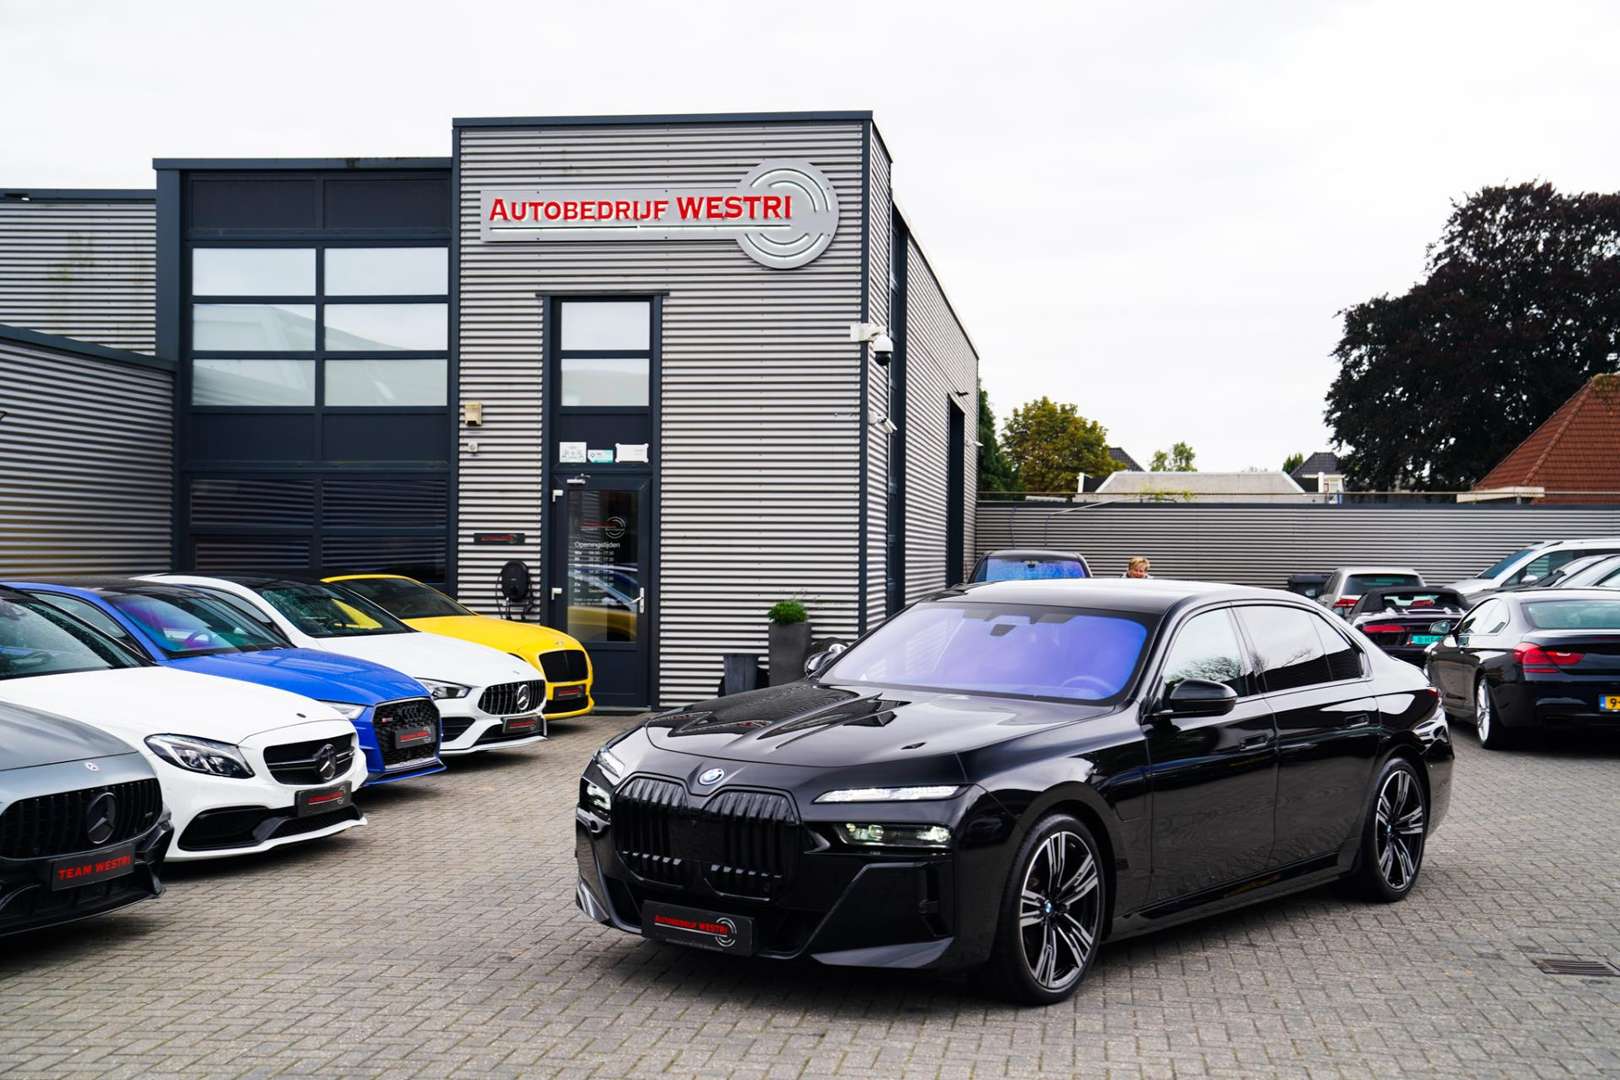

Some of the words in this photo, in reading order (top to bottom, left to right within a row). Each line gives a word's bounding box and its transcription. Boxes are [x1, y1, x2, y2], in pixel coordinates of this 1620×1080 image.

[489, 198, 669, 221] AUTOBEDRIJF
[676, 195, 792, 220] WESTRI
[58, 866, 92, 880] TEAM
